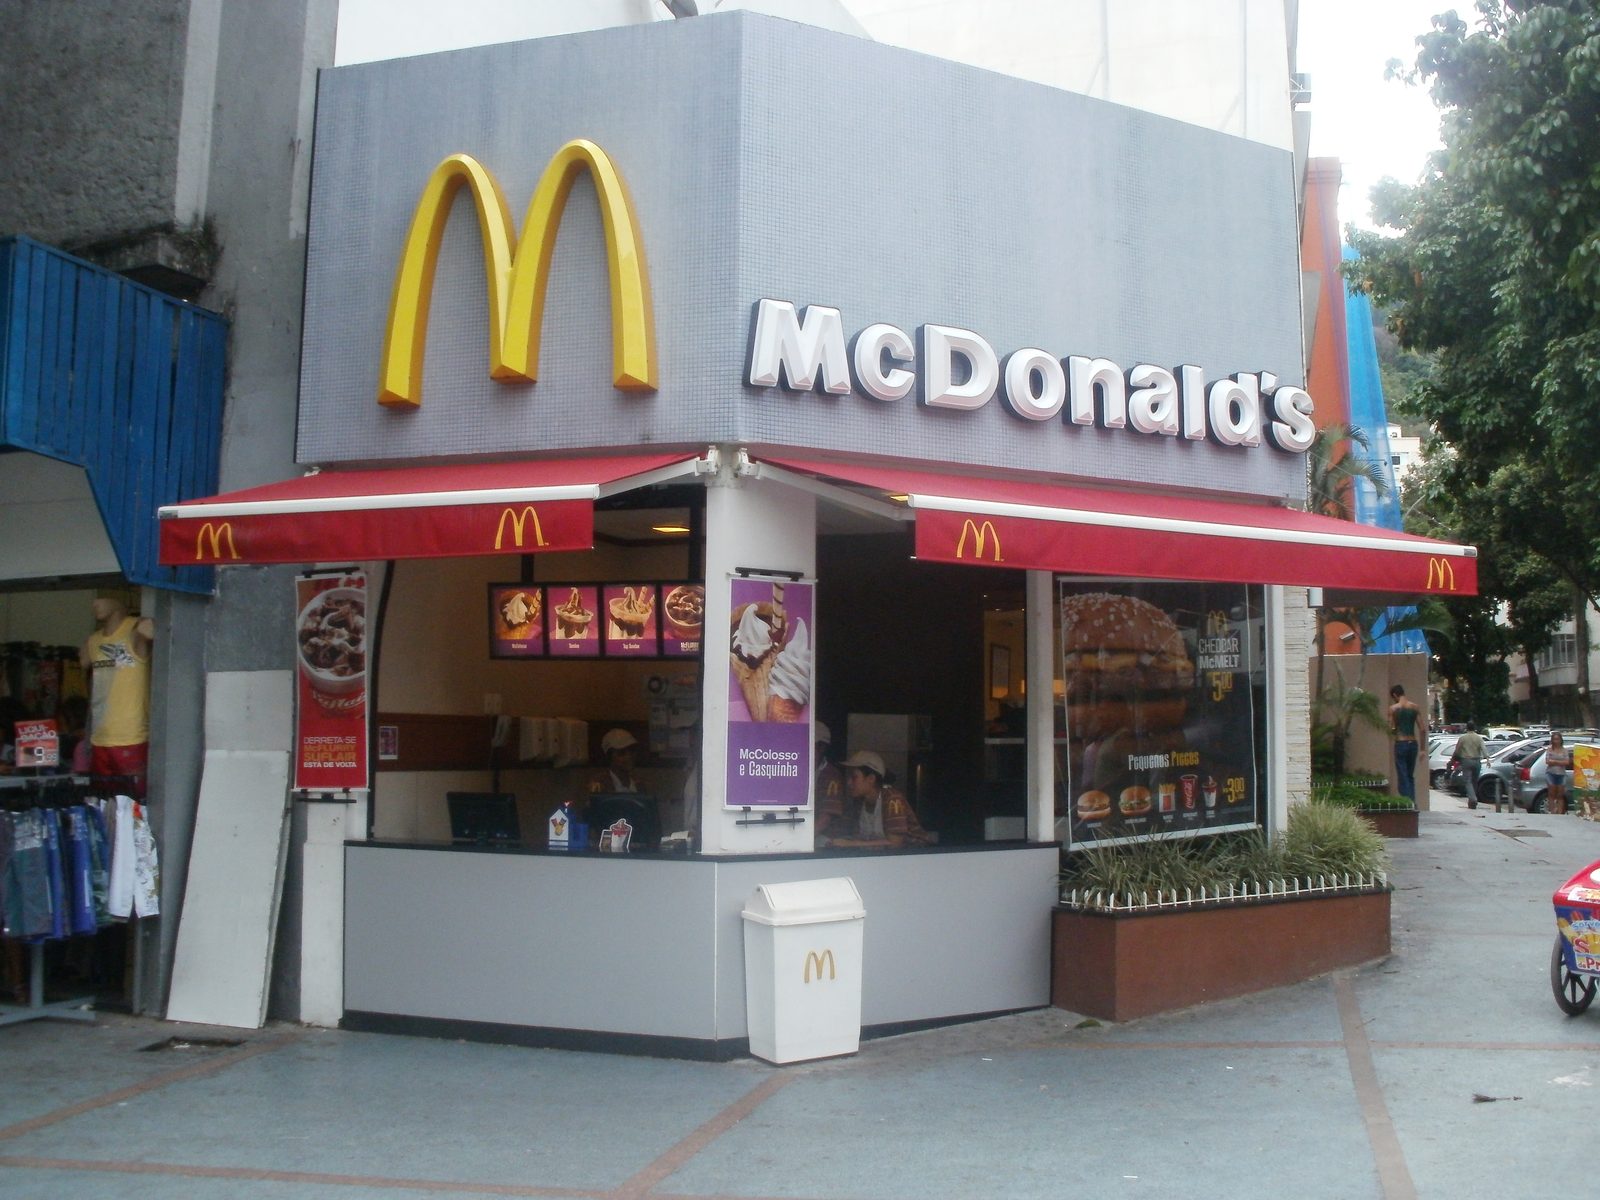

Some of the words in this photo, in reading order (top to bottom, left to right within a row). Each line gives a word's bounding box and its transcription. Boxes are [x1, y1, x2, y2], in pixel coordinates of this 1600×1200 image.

[742, 297, 1316, 453] McDonald's
[1198, 638, 1240, 654] CHEDDAR
[1199, 654, 1240, 669] McMELT
[739, 748, 799, 761] McColosso
[323, 760, 335, 768] DE
[335, 760, 357, 768] VOLTA
[739, 763, 745, 776] e
[748, 760, 798, 779] Casquinha
